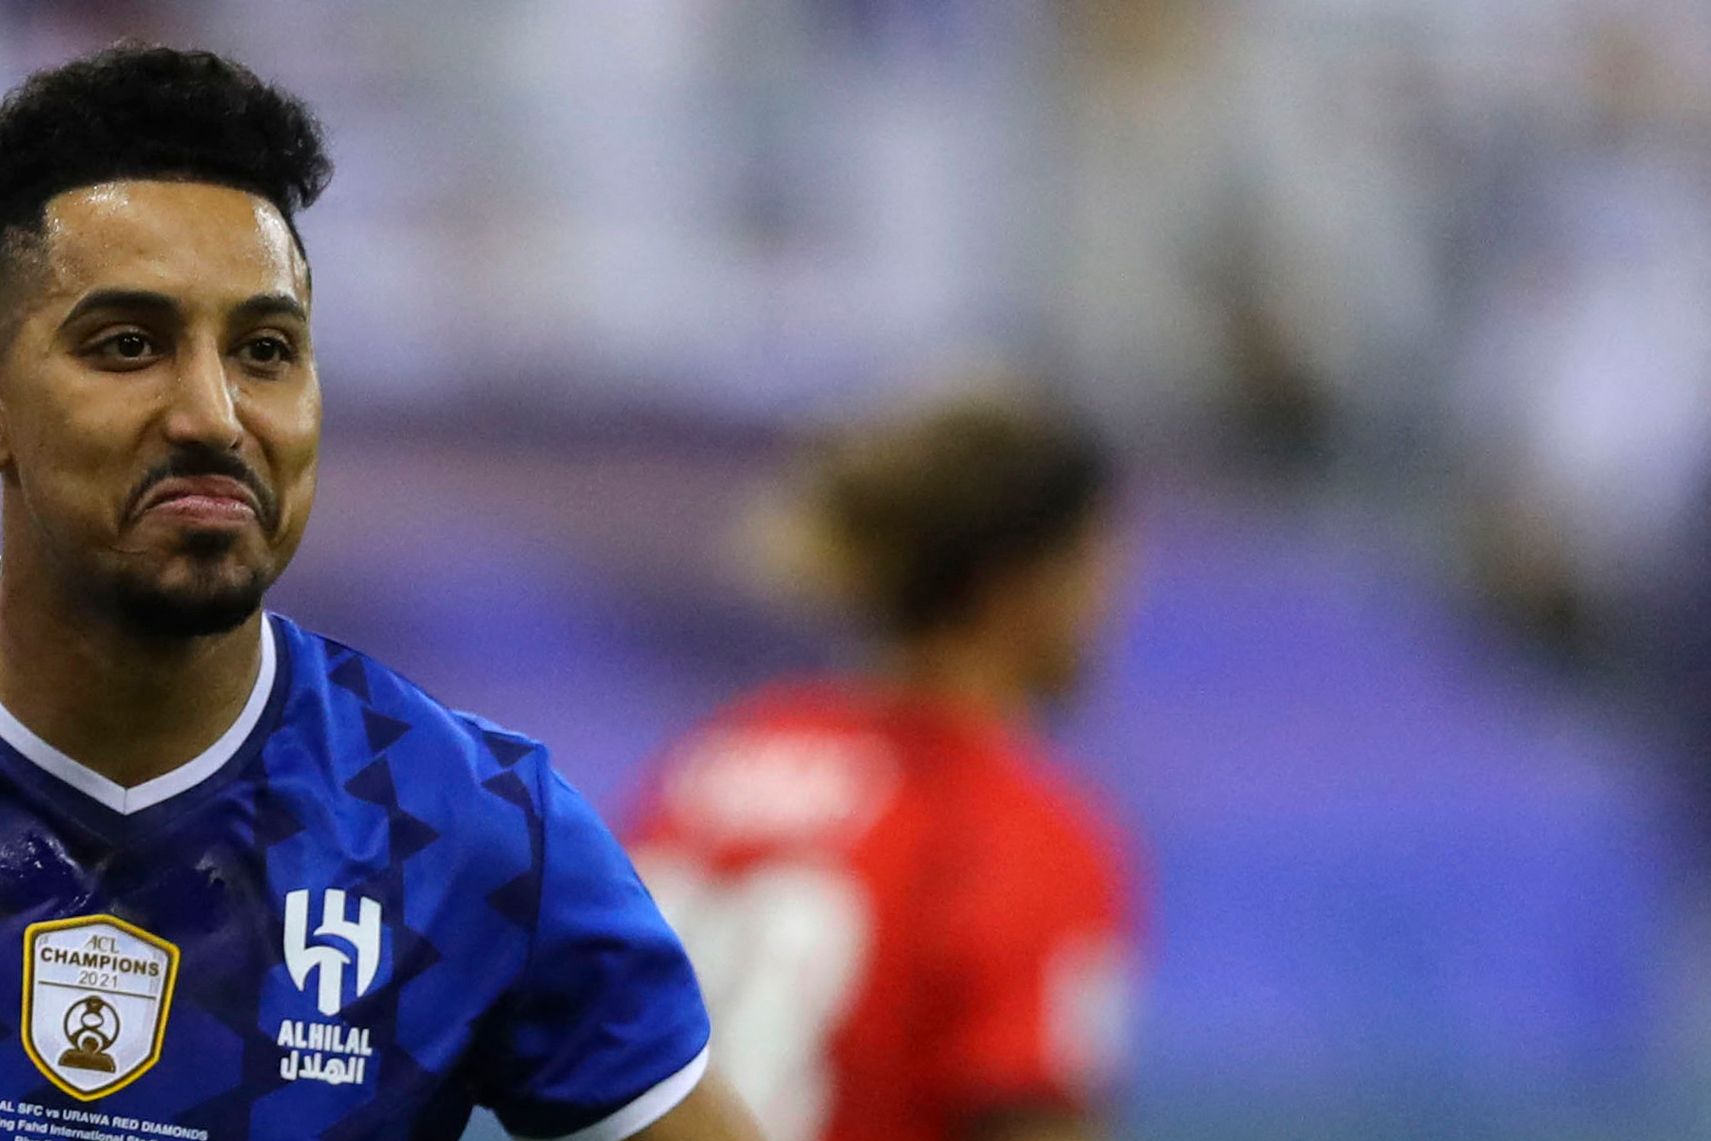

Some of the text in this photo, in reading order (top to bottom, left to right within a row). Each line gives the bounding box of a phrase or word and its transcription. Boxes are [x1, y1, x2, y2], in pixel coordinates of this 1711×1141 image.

[85, 935, 120, 954] ACL
[40, 947, 160, 977] CHAMPIONS
[78, 971, 118, 988] 2021
[277, 1019, 373, 1056] ALHILAL
[280, 1050, 365, 1085] الهلال
[17, 1104, 43, 1117] SFC
[45, 1109, 59, 1119] vs
[62, 1109, 109, 1126] URAWA
[112, 1116, 139, 1131] RED
[141, 1121, 208, 1141] DIAMONDS
[17, 1119, 48, 1134] Fahd
